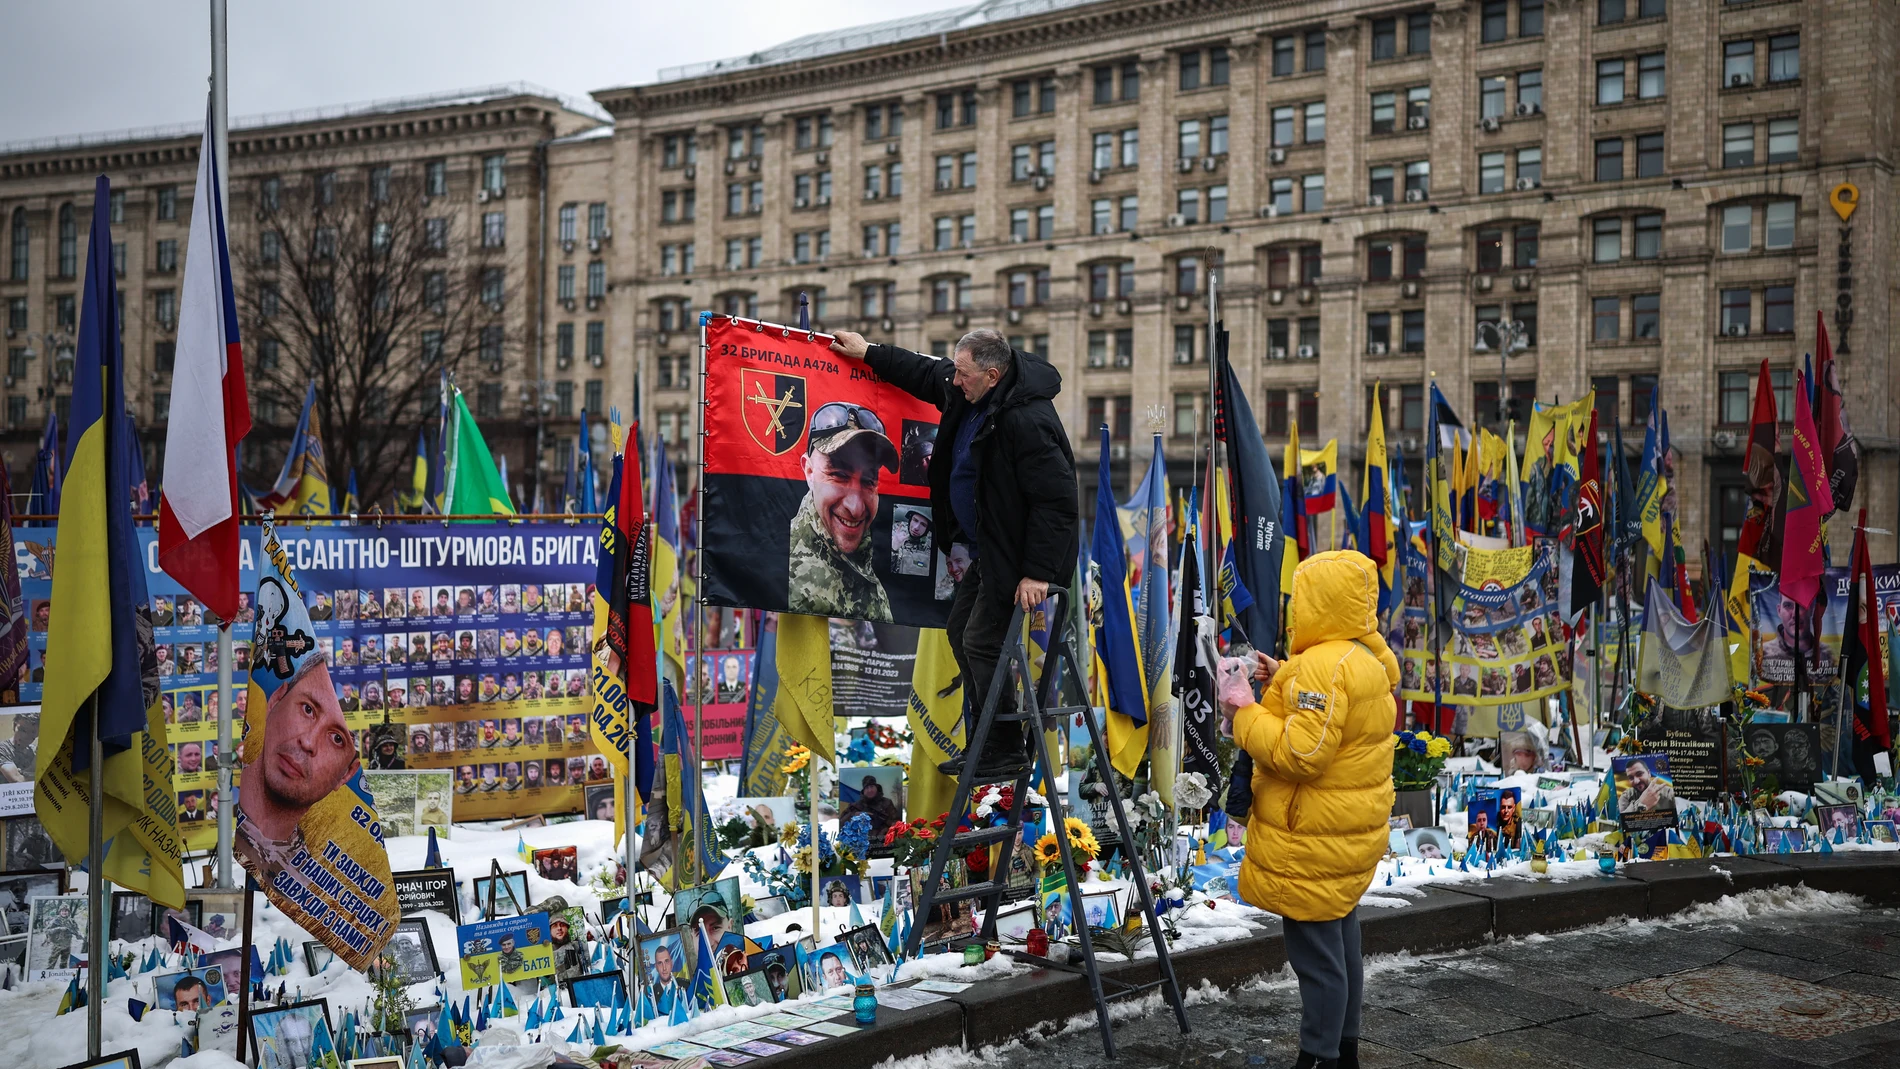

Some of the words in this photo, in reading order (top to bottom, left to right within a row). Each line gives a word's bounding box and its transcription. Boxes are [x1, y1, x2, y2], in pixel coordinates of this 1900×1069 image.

[720, 343, 738, 357] 32
[741, 346, 801, 368] БРИГАДА
[803, 357, 840, 375] А4784
[282, 535, 526, 571] ЕСАНТНО-ШТУРМОВА
[531, 535, 600, 568] БРИГА
[1665, 729, 1692, 739] Бубись
[1642, 739, 1668, 748] Сергій
[1669, 739, 1715, 748] Віталійович
[62, 765, 73, 781] час
[350, 805, 367, 830] 82
[321, 840, 336, 862] ТИ
[335, 854, 386, 900] ЗАВЖДИ
[290, 851, 303, 867] В
[300, 857, 342, 901] НАШИХ
[339, 890, 384, 934] СЕРЦЯХ
[395, 881, 423, 893] РНАЧ
[425, 879, 448, 891] ІГОР
[418, 900, 445, 908] 28.04.2025
[273, 871, 324, 921] ЗАВЖДИ
[323, 910, 336, 928] З
[332, 916, 368, 955] НАМИ
[475, 920, 504, 931] Назавжди
[508, 917, 528, 926] строю
[487, 927, 507, 935] наших
[523, 956, 551, 972] БАТЯ
